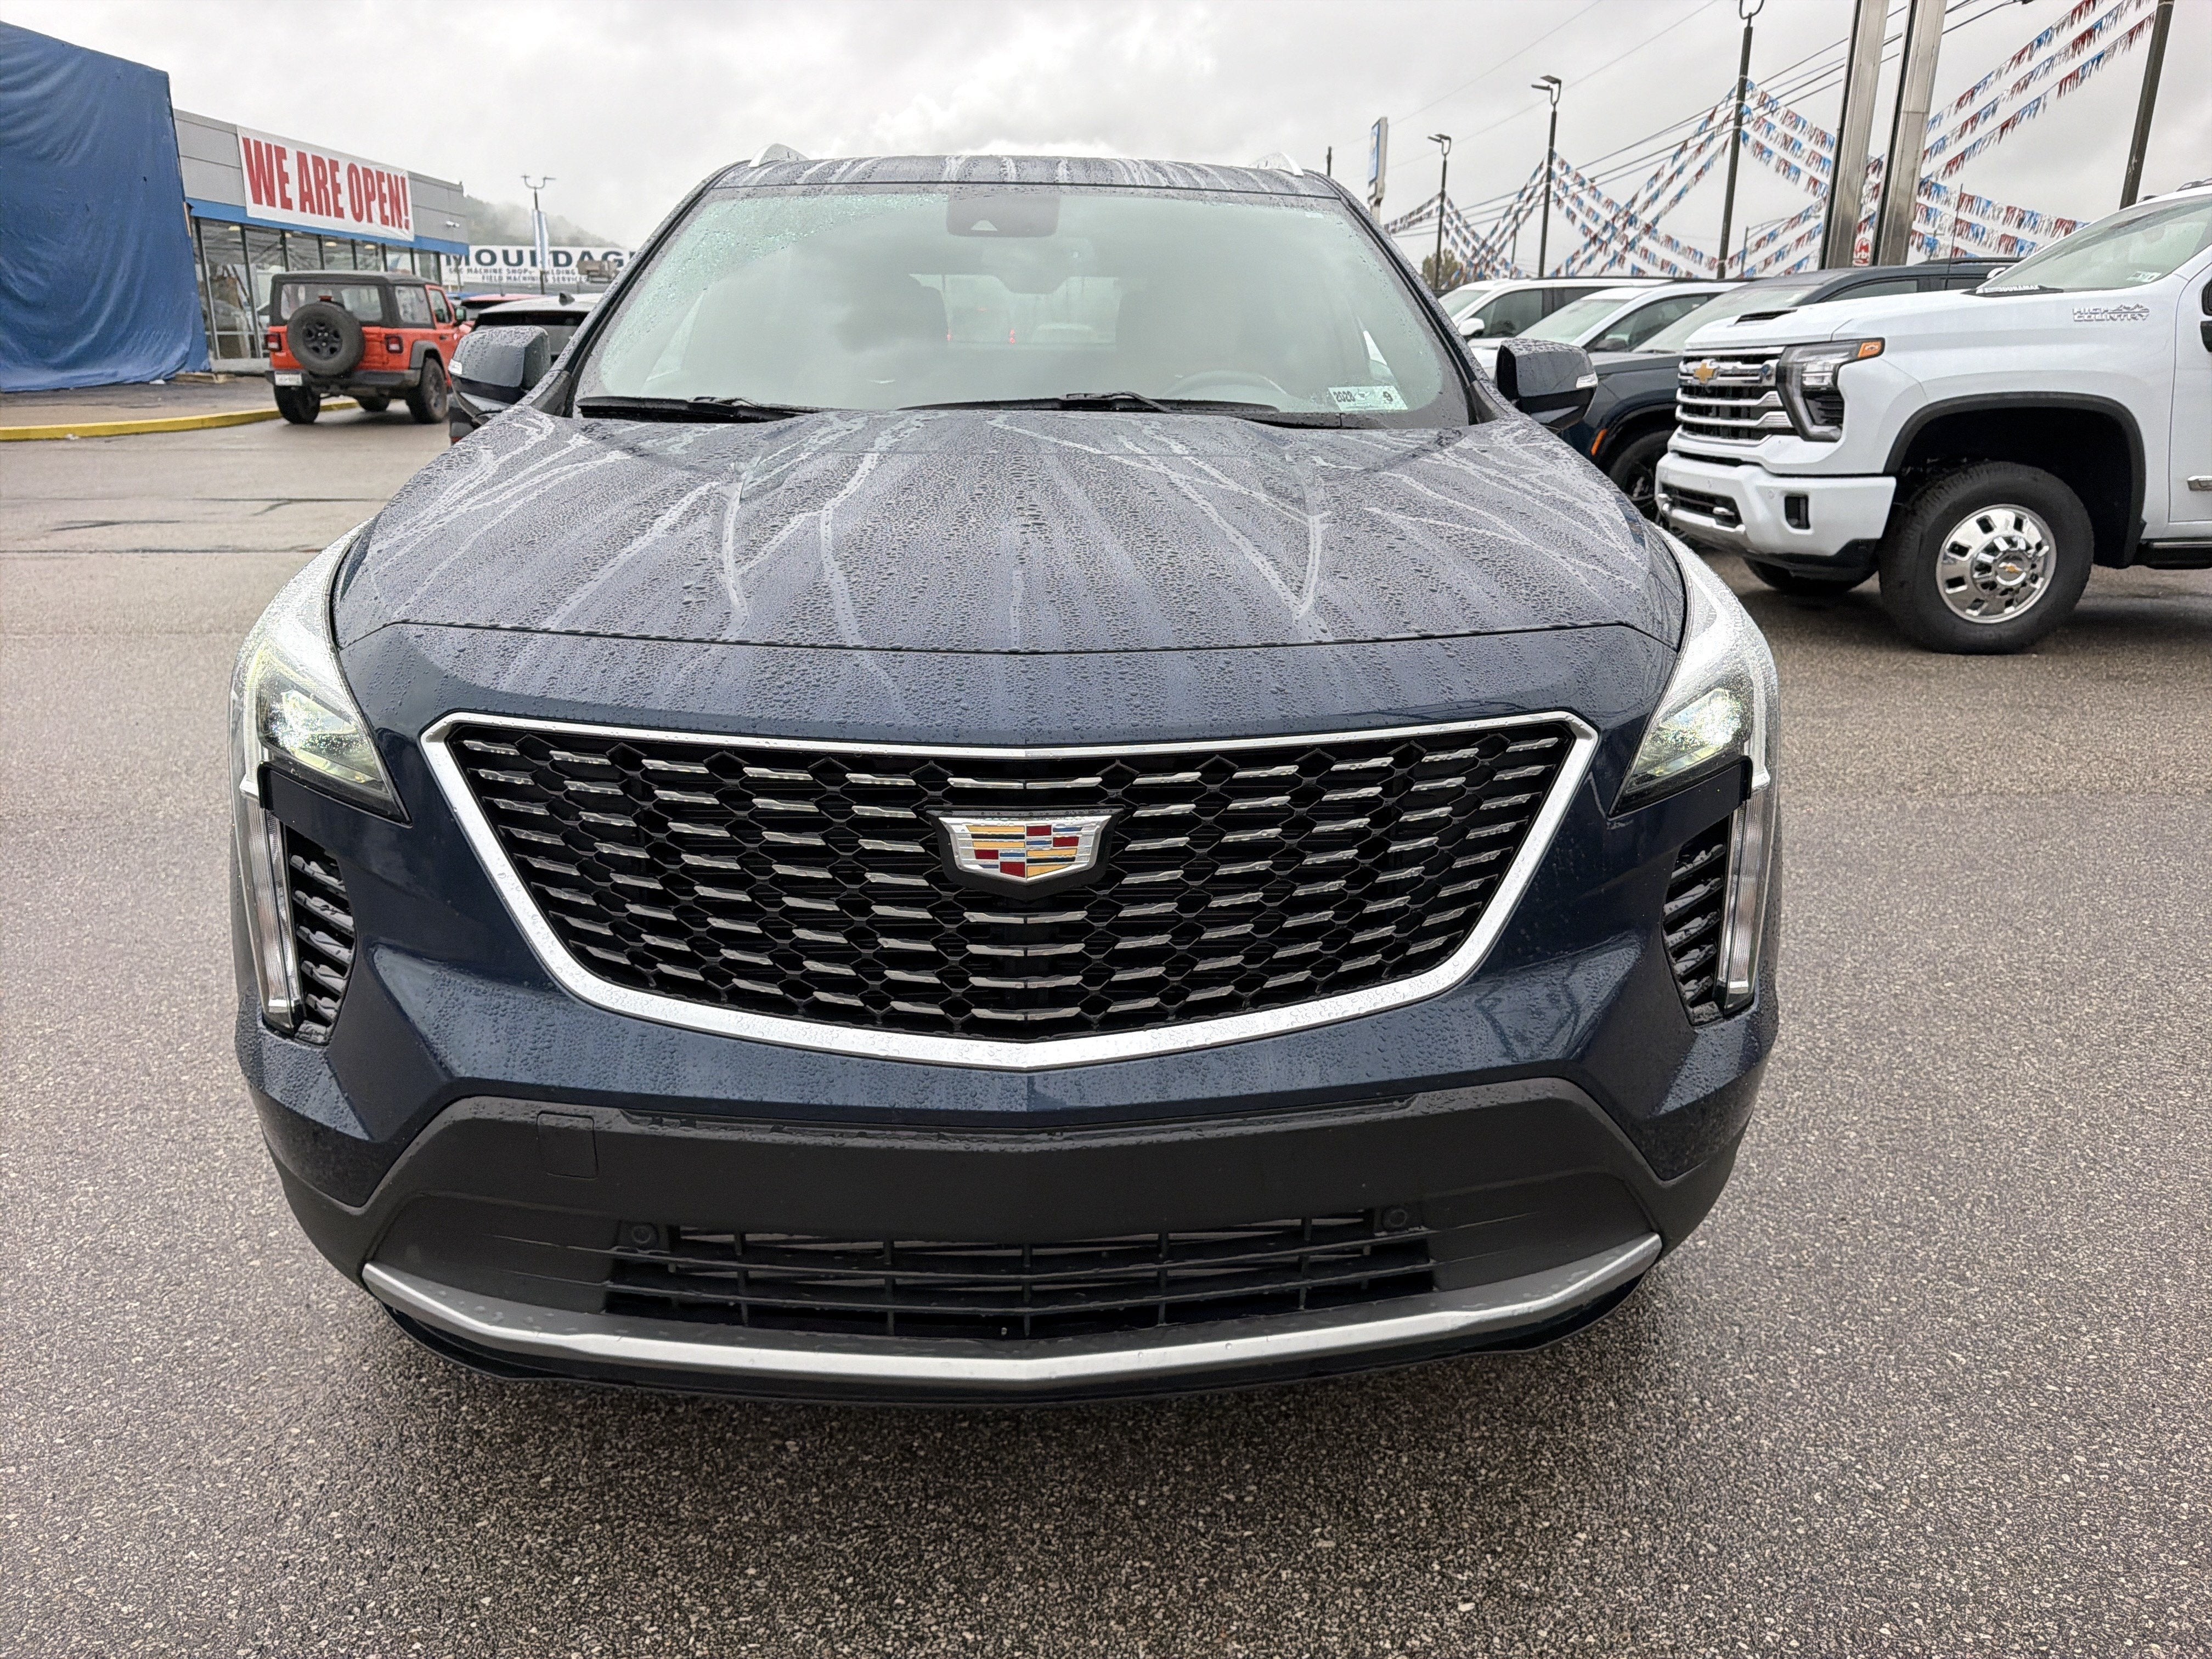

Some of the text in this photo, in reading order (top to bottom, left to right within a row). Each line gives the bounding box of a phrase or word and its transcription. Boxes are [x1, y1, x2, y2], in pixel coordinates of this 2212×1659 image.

[242, 137, 409, 230] WE ARE OPEN!
[2073, 313, 2149, 322] COUNTRY
